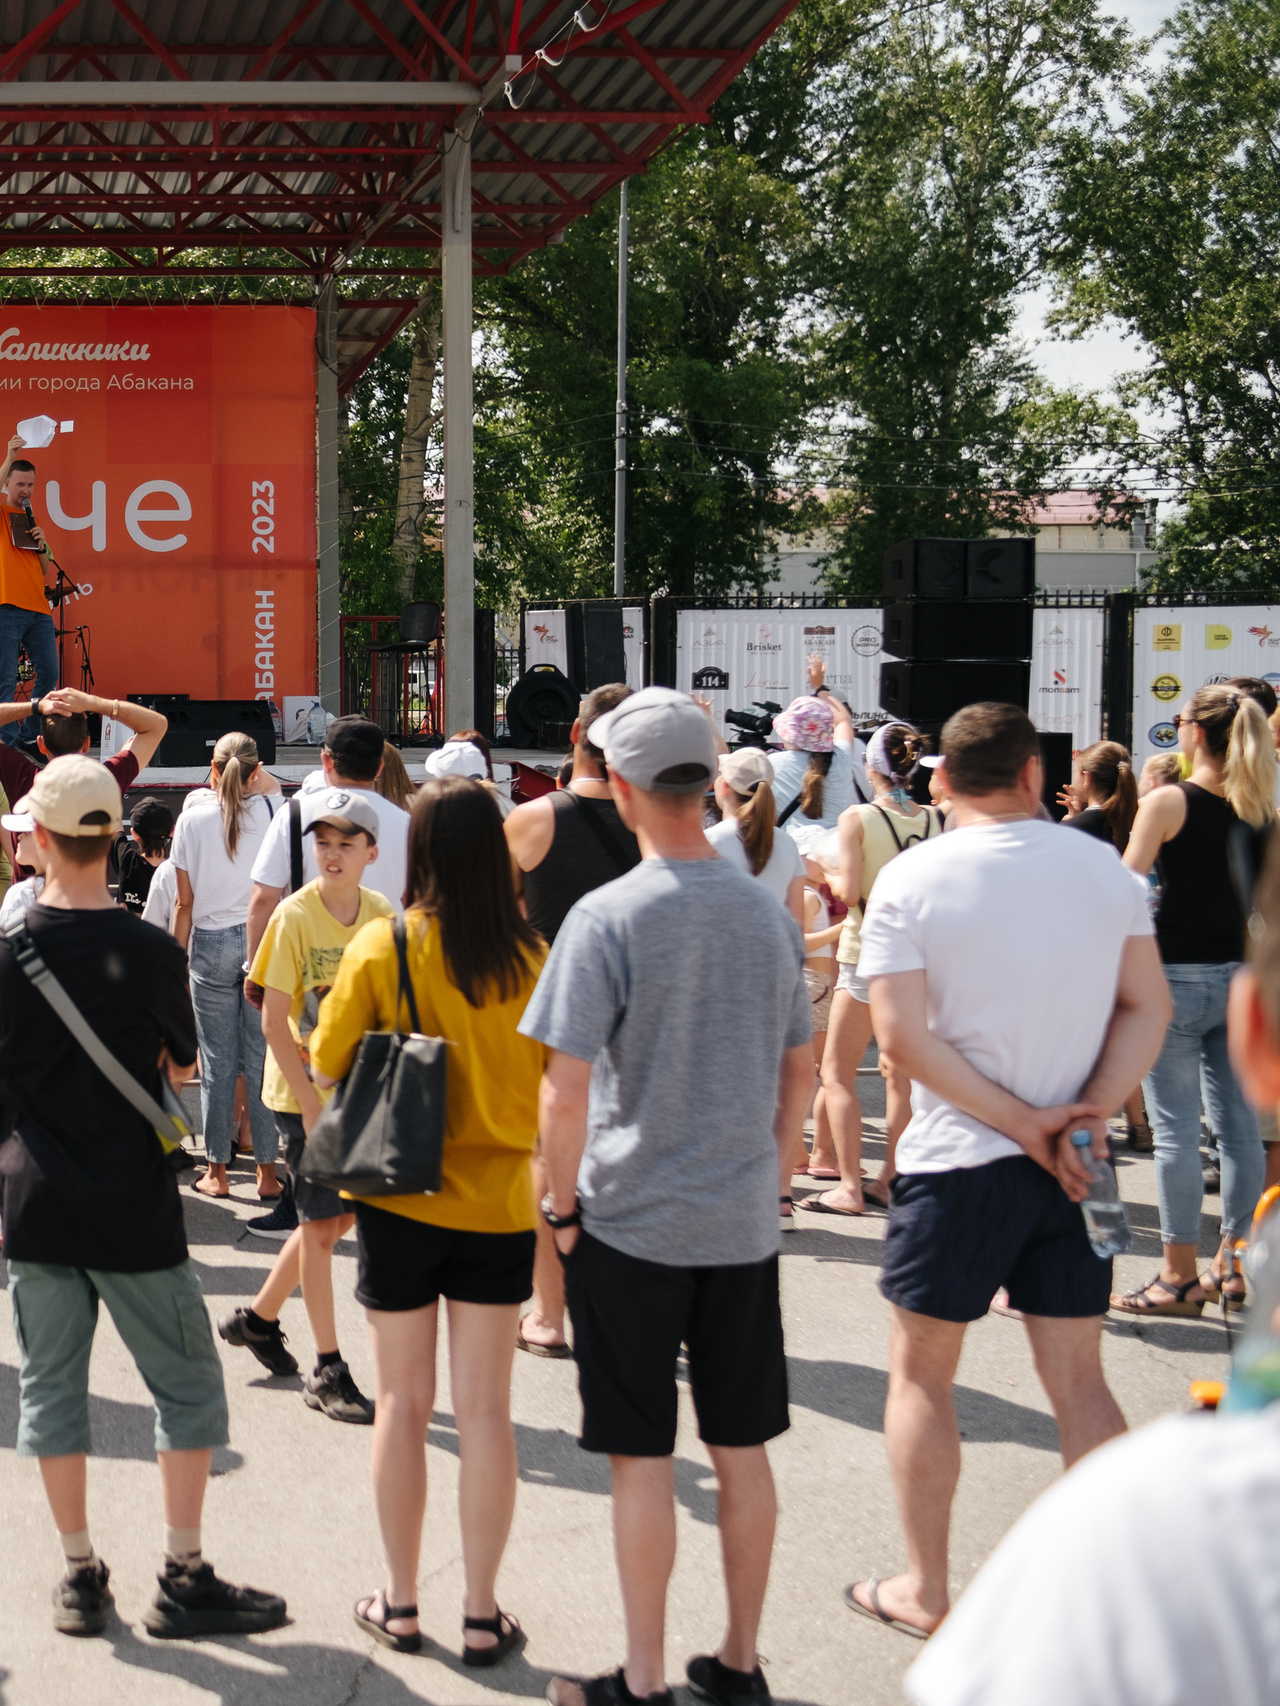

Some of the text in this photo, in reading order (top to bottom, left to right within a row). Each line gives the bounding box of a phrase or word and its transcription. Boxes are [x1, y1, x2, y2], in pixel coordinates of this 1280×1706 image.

[29, 376, 101, 394] города
[106, 373, 194, 391] Абакана
[251, 479, 275, 554] 2023
[746, 642, 782, 651] Brisket
[701, 676, 720, 687] 114
[1039, 686, 1080, 694] monsam
